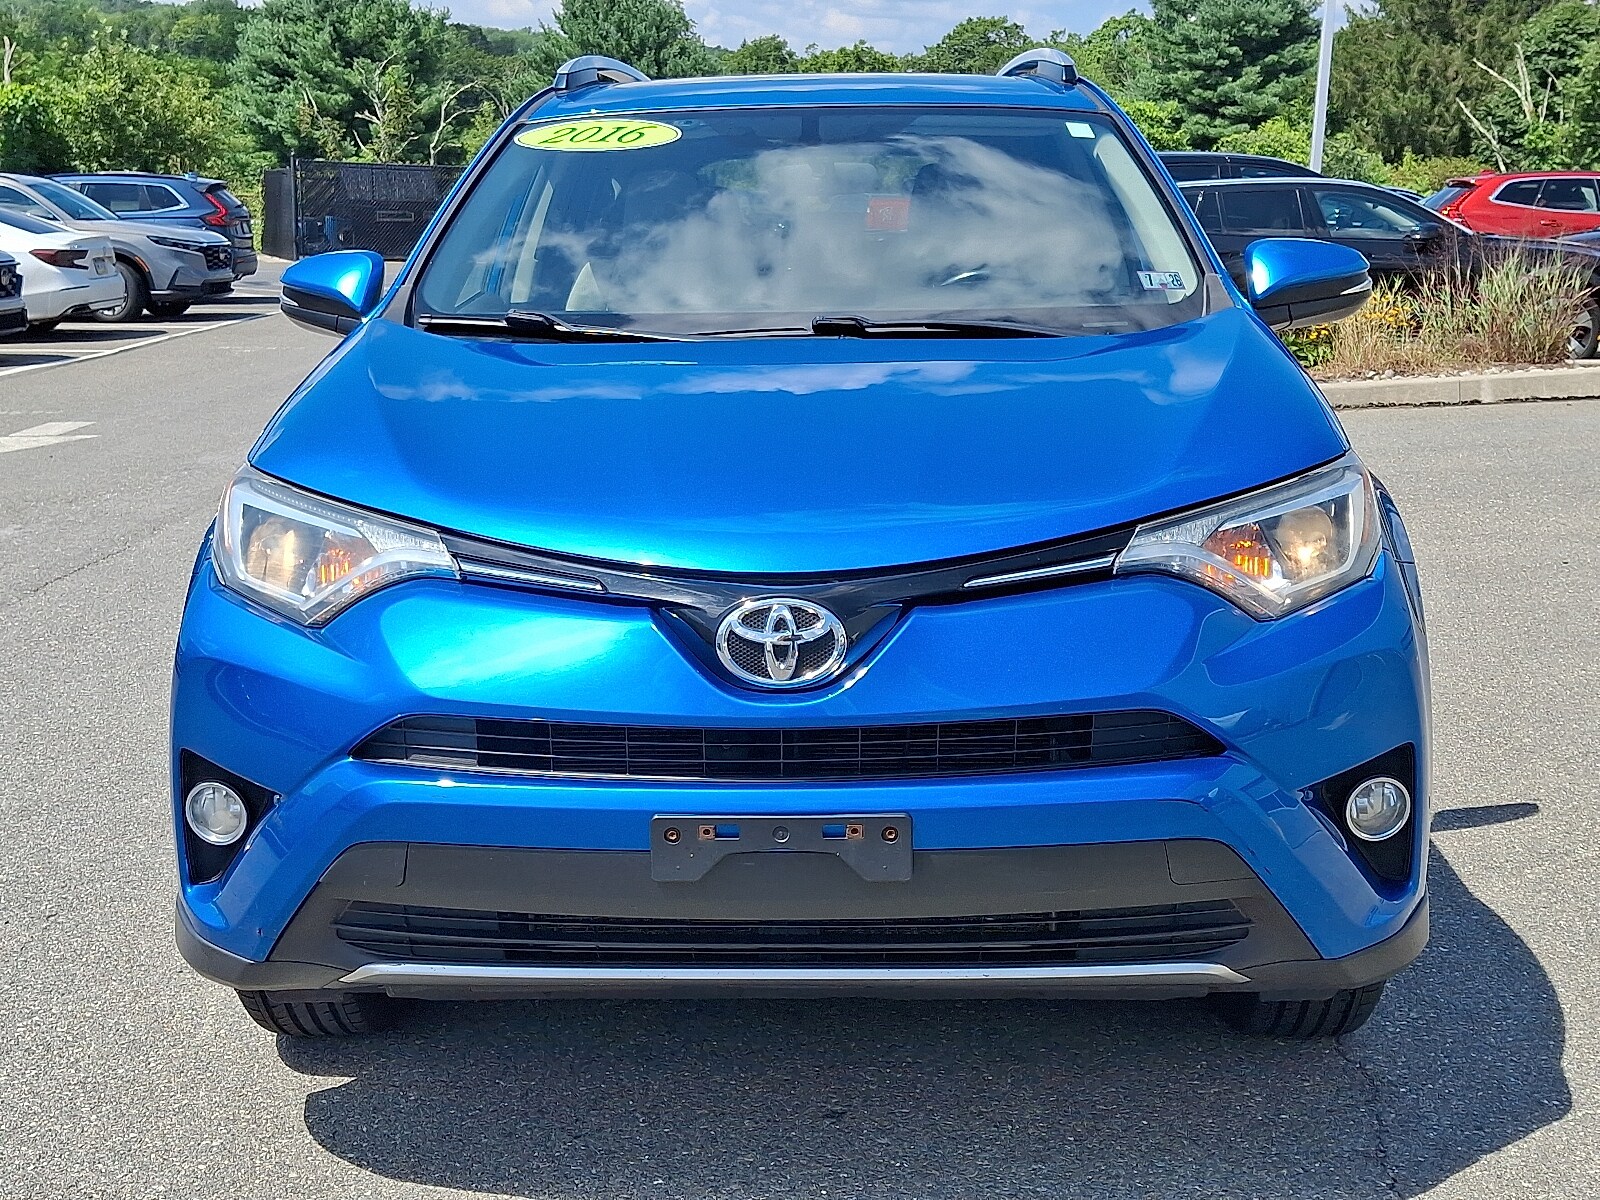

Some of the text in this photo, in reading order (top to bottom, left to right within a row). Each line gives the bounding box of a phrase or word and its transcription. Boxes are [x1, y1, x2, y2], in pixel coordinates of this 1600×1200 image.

[538, 126, 657, 144] 2016
[1144, 273, 1183, 287] 7 26
